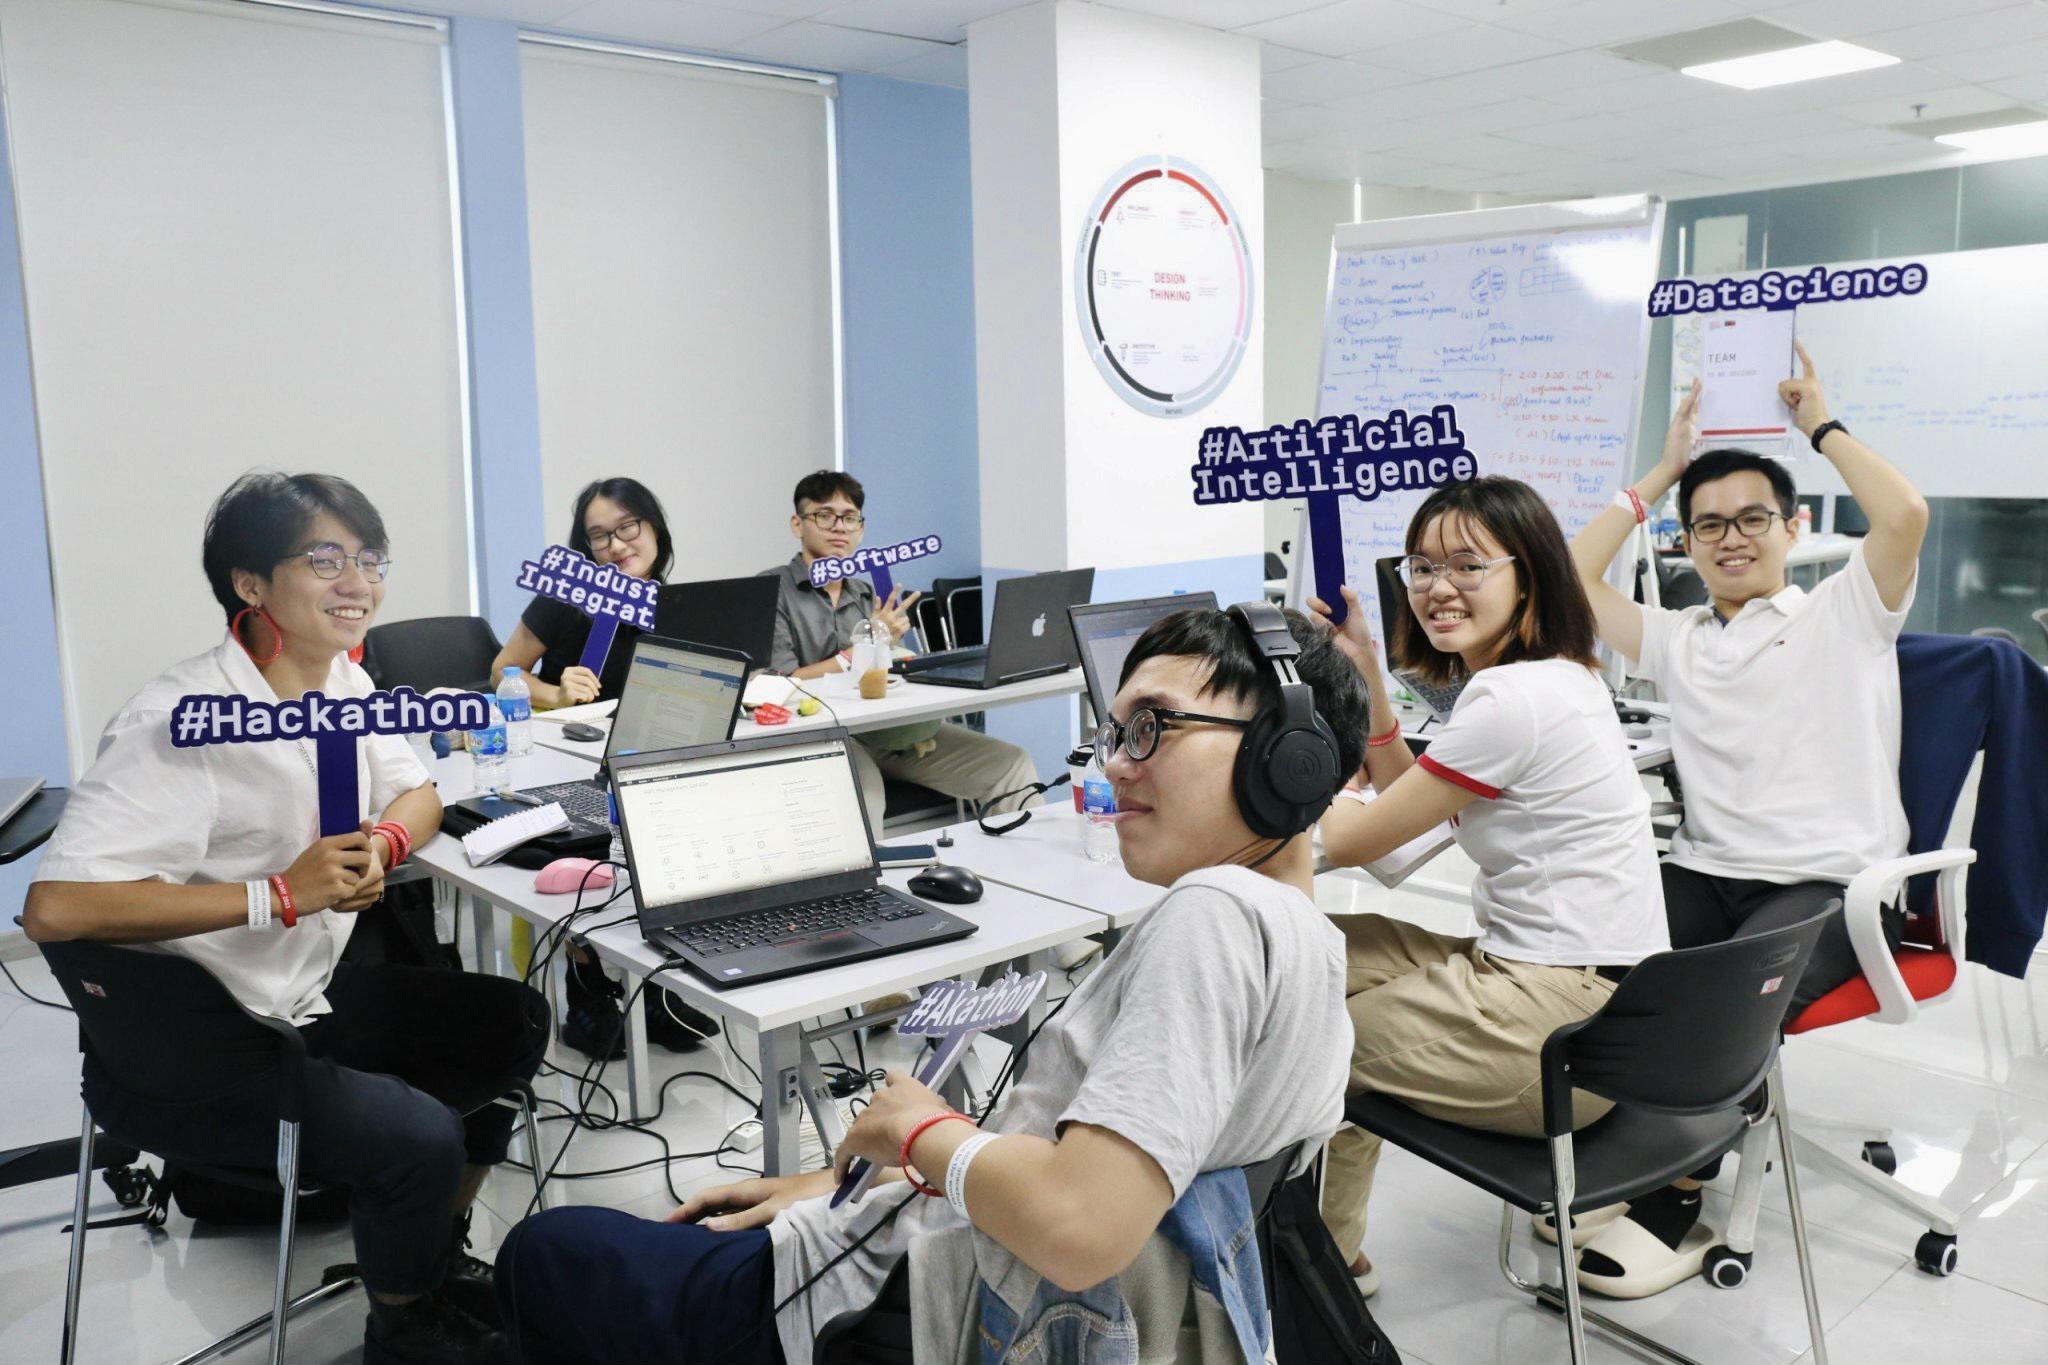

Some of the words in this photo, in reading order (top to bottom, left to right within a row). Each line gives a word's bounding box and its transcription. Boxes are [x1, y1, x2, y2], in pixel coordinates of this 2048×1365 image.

[1149, 289, 1191, 302] THINKING
[1154, 272, 1185, 285] DESIGN
[1652, 266, 1923, 312] #DataScience
[1708, 353, 1736, 363] TEAM
[1203, 411, 1459, 467] #Artificial
[1195, 454, 1473, 500] Intelligence
[542, 549, 658, 605] #Indust
[812, 536, 940, 584] #Software
[520, 564, 655, 630] Integrat
[177, 692, 484, 742] #Hackathon
